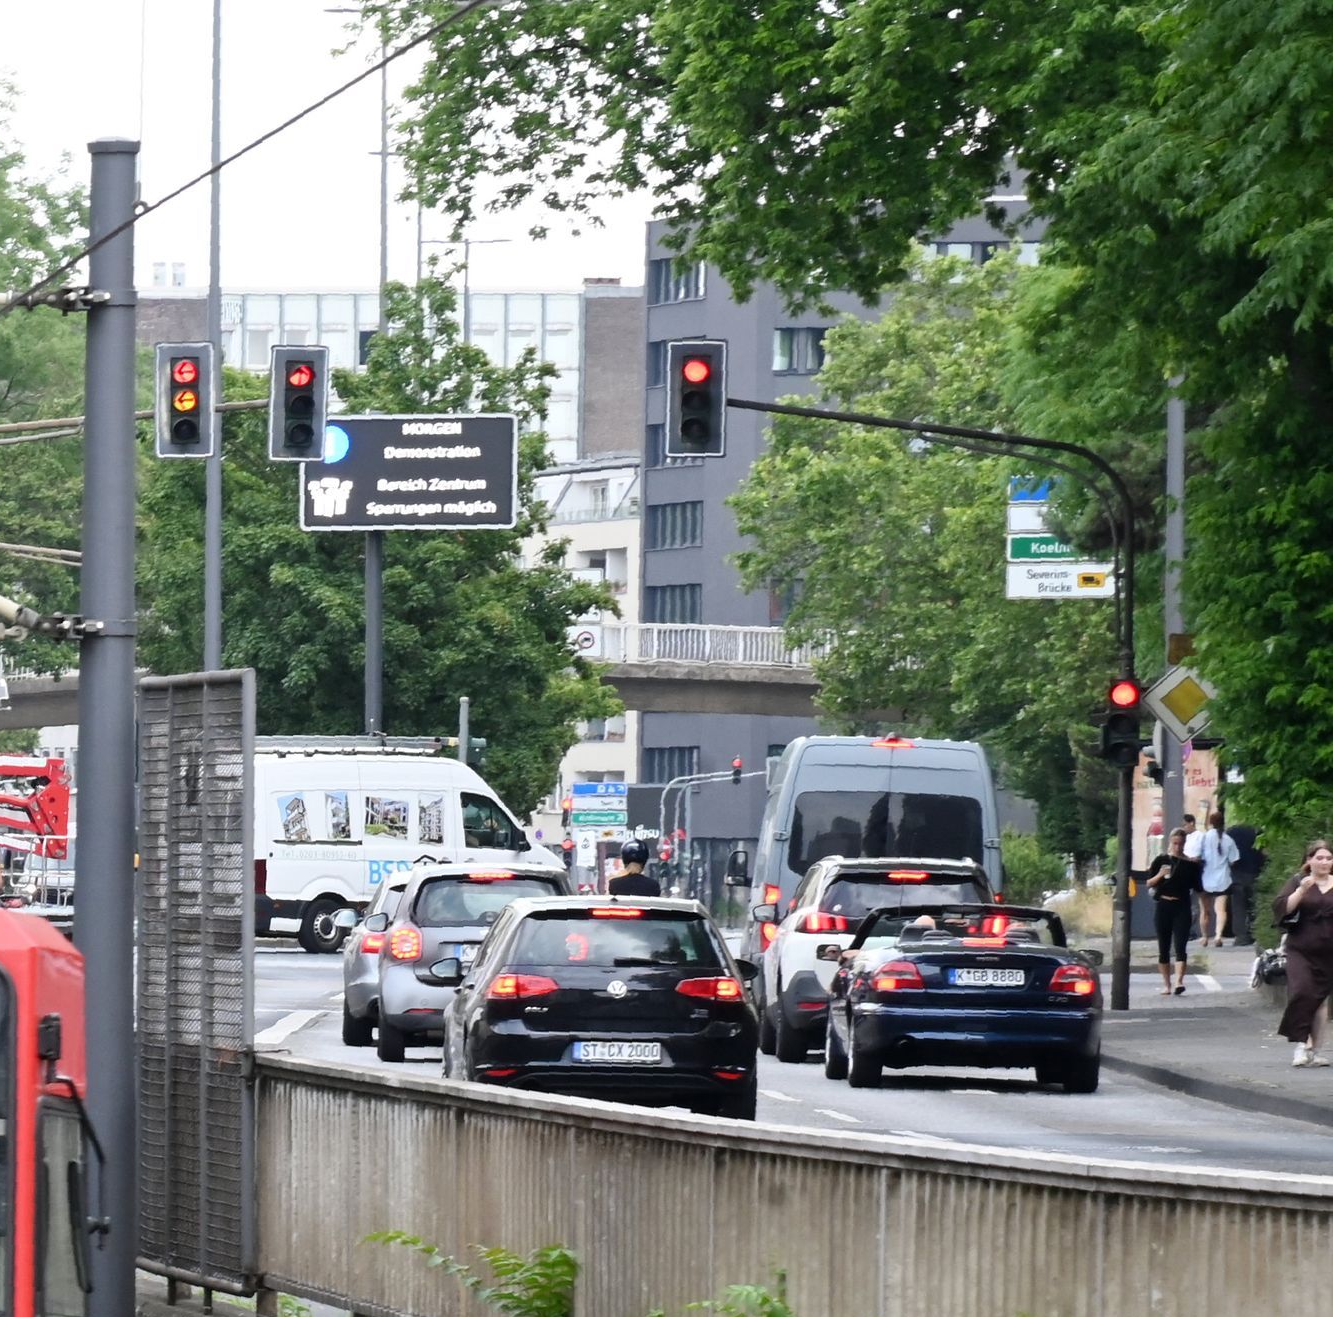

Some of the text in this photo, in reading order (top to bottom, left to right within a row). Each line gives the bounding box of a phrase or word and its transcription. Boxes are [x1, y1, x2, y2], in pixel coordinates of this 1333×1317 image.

[402, 422, 462, 435] MORGEN
[383, 446, 481, 459] Demonstration
[377, 478, 486, 492] Bereich Zentrum
[366, 501, 497, 517] Sperrungen möglich
[1030, 542, 1071, 555] Koeln
[1026, 569, 1071, 580] Severins-
[1037, 583, 1072, 593] Brücke
[583, 1043, 659, 1058] ST CX 2000
